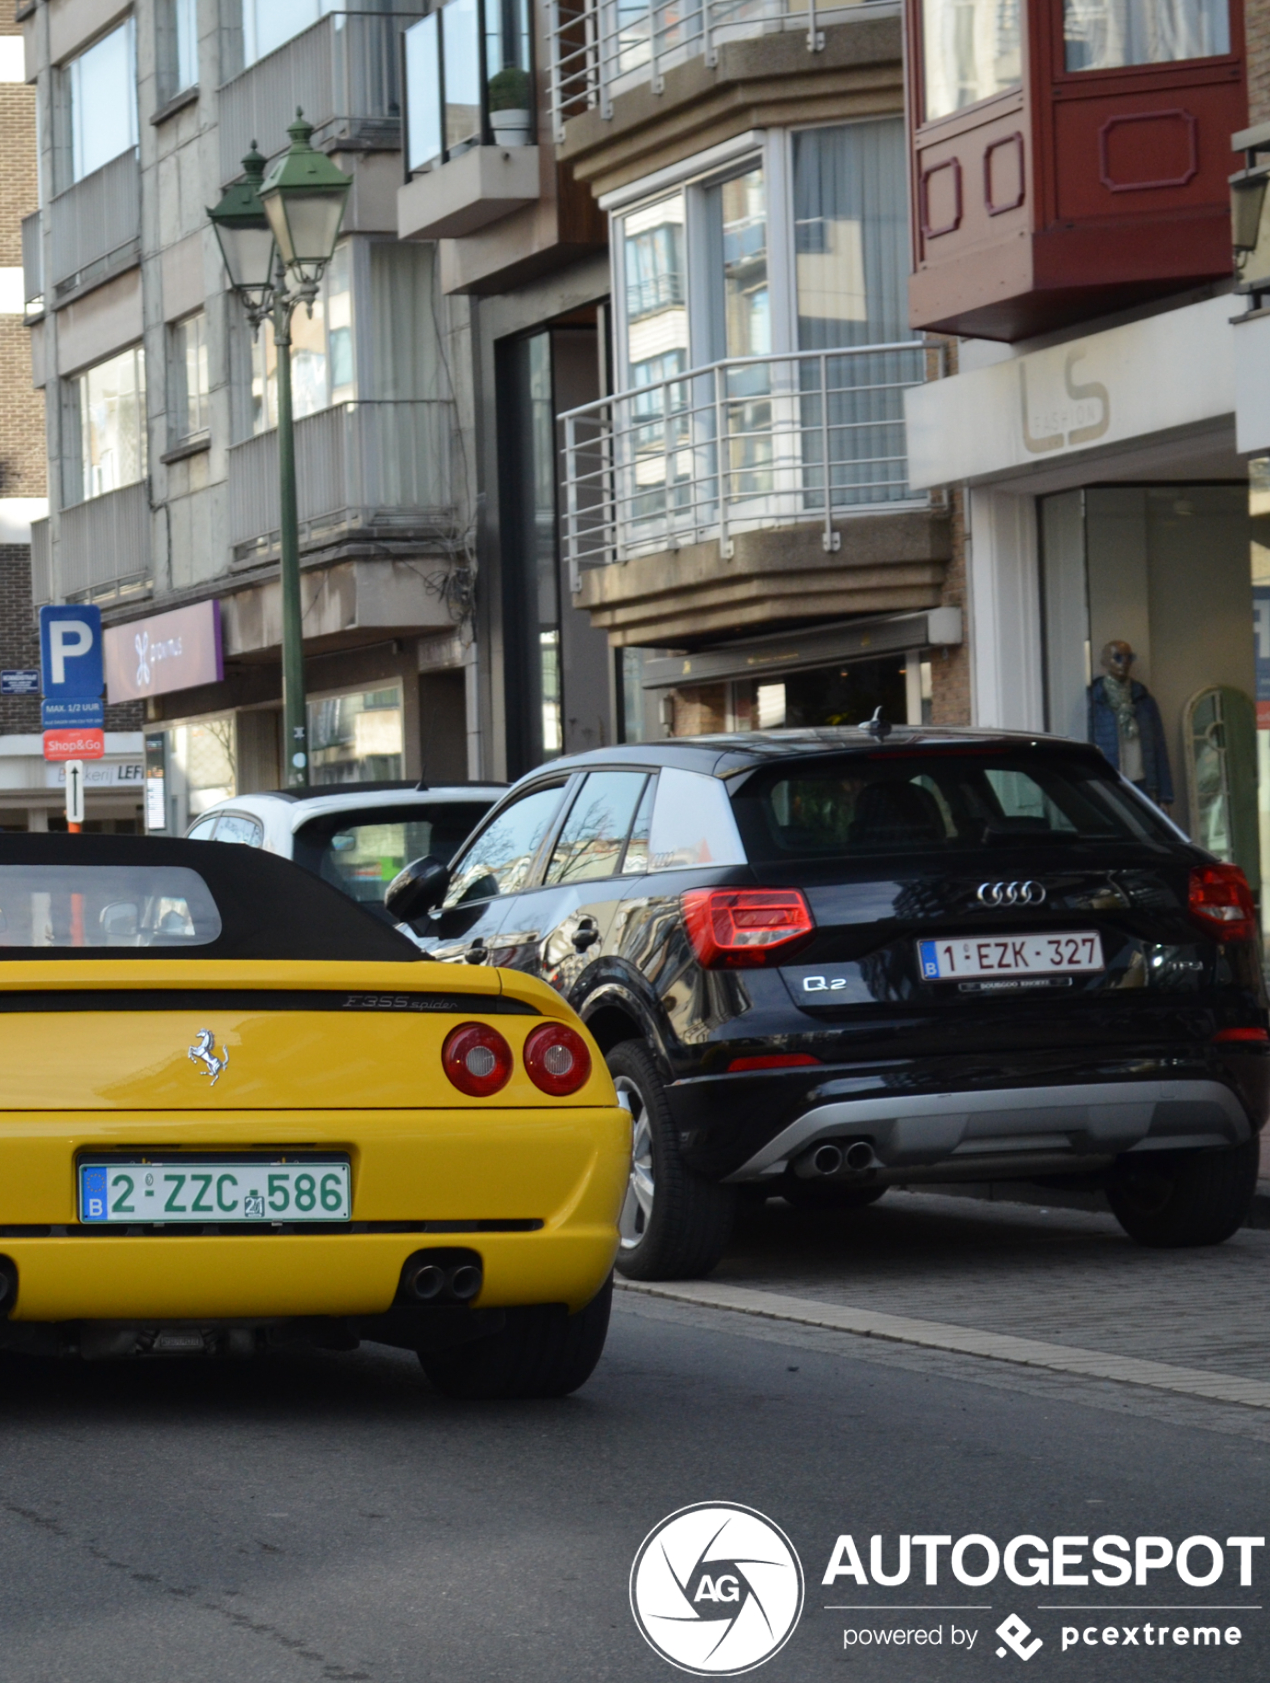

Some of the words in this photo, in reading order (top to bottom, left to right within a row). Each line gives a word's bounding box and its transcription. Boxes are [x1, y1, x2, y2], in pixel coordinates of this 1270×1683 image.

[50, 621, 93, 683] P
[68, 703, 81, 713] 1/2
[82, 702, 100, 711] UUR
[47, 739, 101, 753] Shop&Go
[926, 962, 938, 976] B
[803, 975, 847, 991] Q2
[342, 995, 410, 1008] F355
[89, 1199, 103, 1216] B
